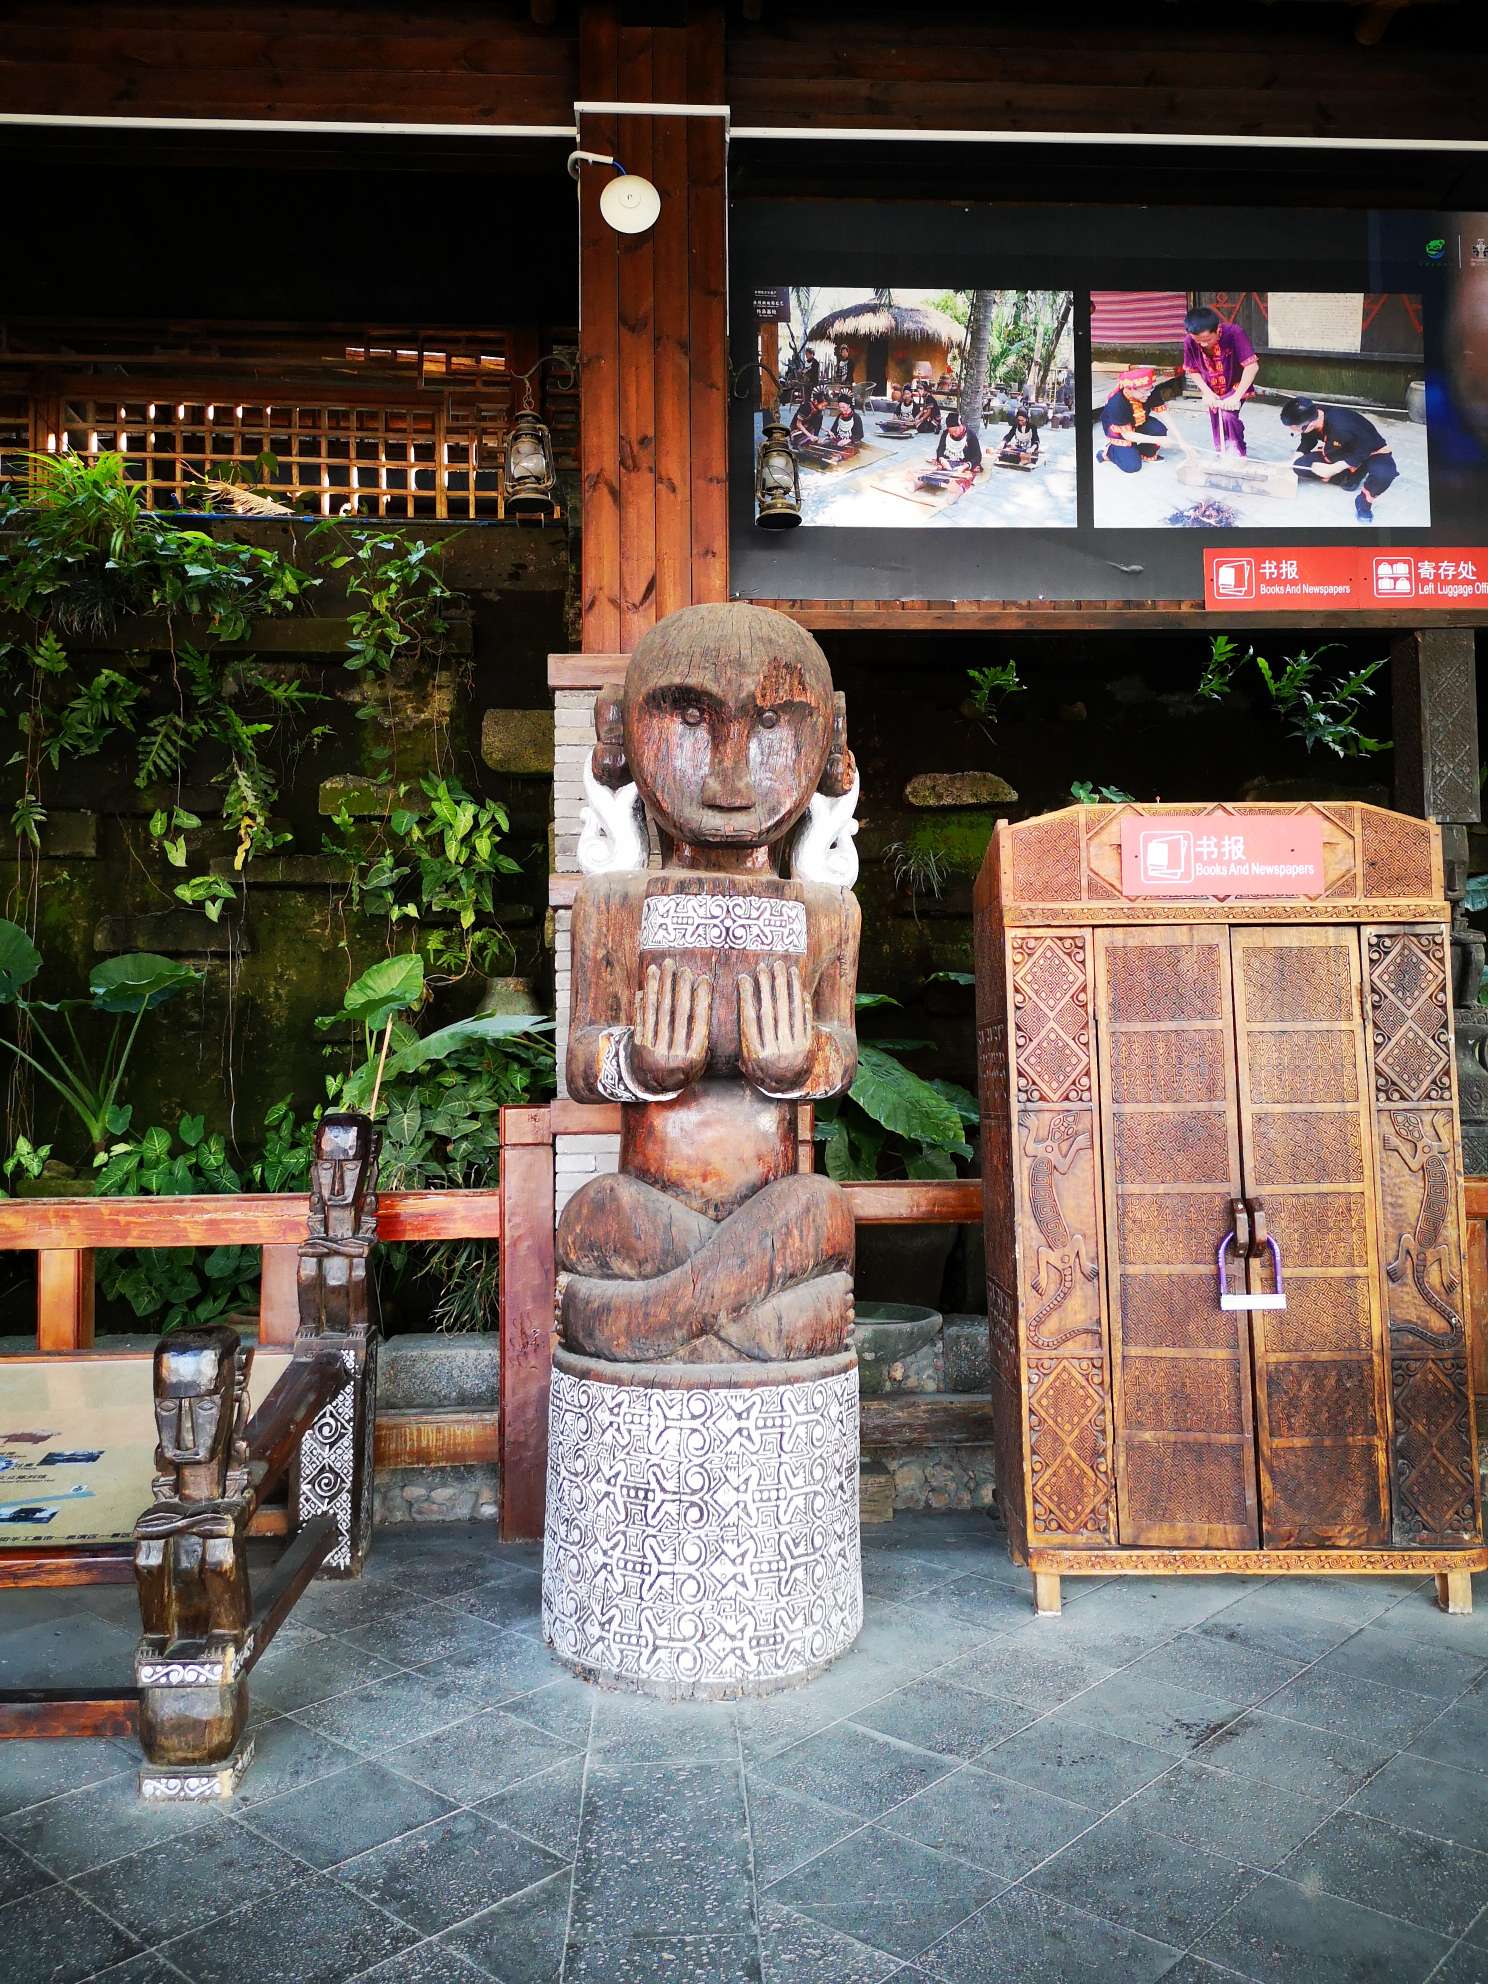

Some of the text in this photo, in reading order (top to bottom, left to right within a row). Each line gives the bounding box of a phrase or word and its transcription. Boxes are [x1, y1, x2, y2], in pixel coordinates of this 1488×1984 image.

[1260, 560, 1299, 579] 书报
[1418, 561, 1477, 579] 寄存处
[1260, 584, 1350, 596] Books And Newspapers
[1418, 582, 1434, 594] Left
[1438, 582, 1473, 597] Luggage
[1195, 836, 1246, 860] 书报
[1195, 863, 1314, 877] Books And Newspapers
